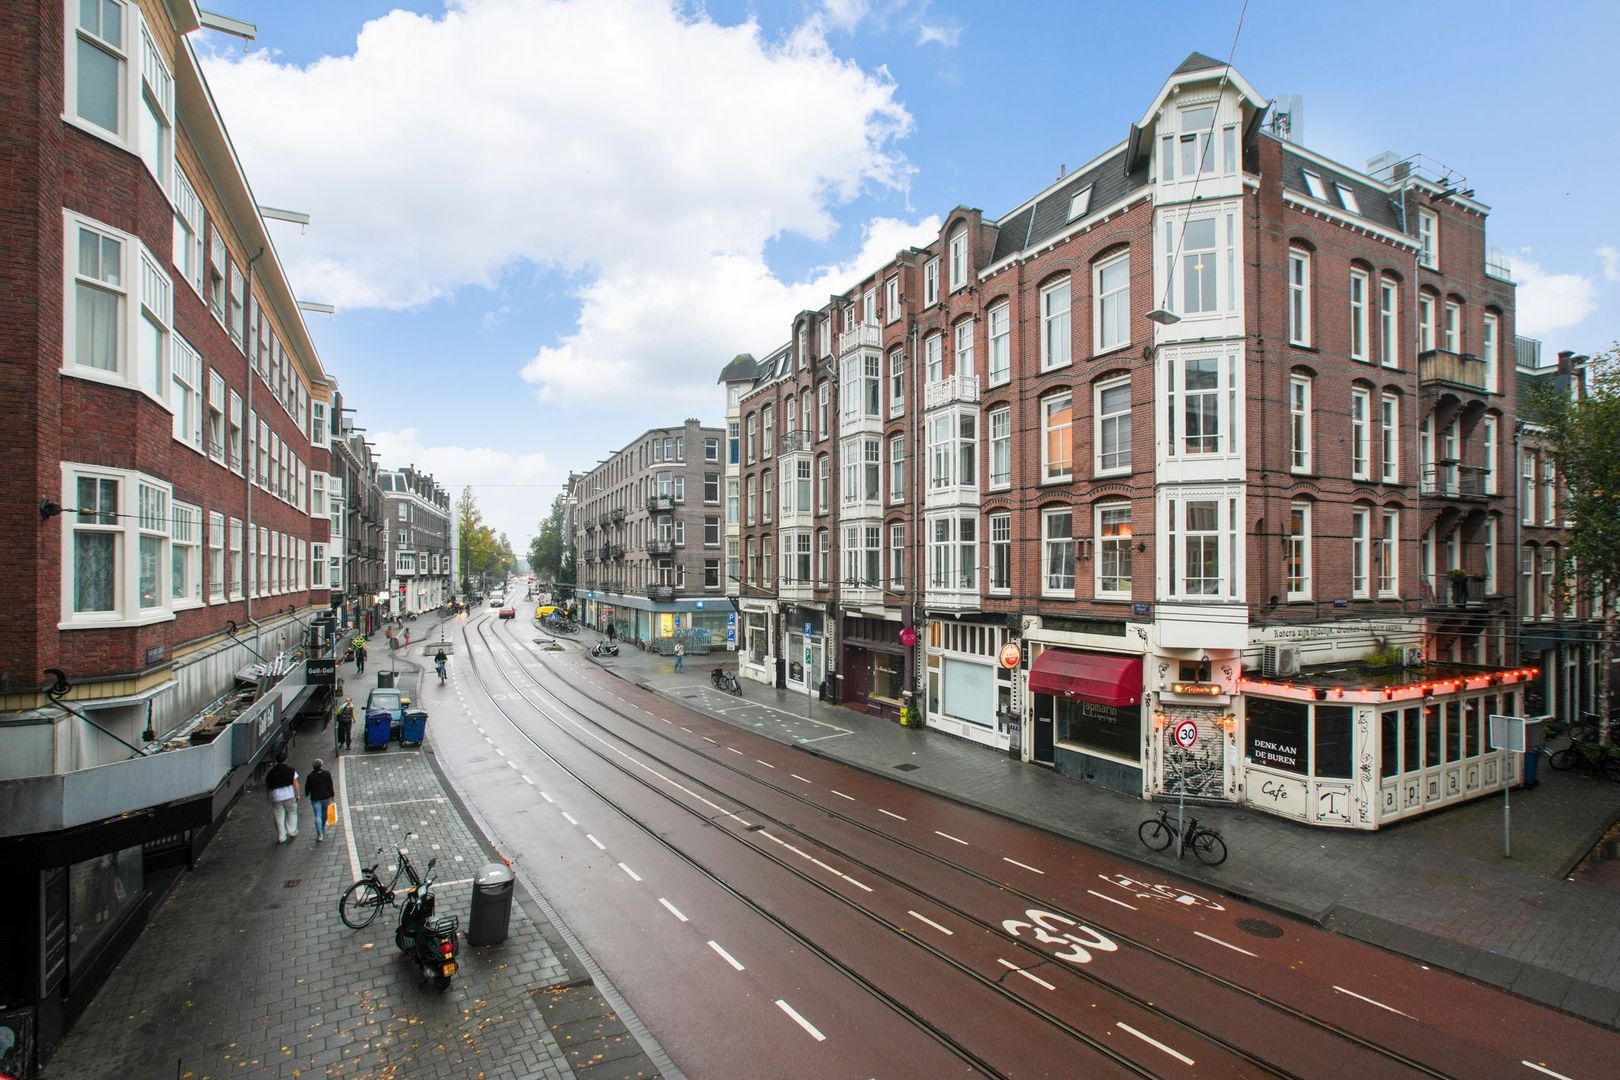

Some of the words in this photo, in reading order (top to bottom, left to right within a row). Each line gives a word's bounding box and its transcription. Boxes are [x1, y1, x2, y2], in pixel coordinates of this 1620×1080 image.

[728, 629, 734, 637] P
[1180, 729, 1195, 740] 30
[1254, 739, 1278, 752] DENK
[1278, 744, 1297, 755] AAN
[1255, 750, 1267, 759] DE
[1267, 753, 1296, 765] BUREN
[1001, 908, 1119, 964] 30
